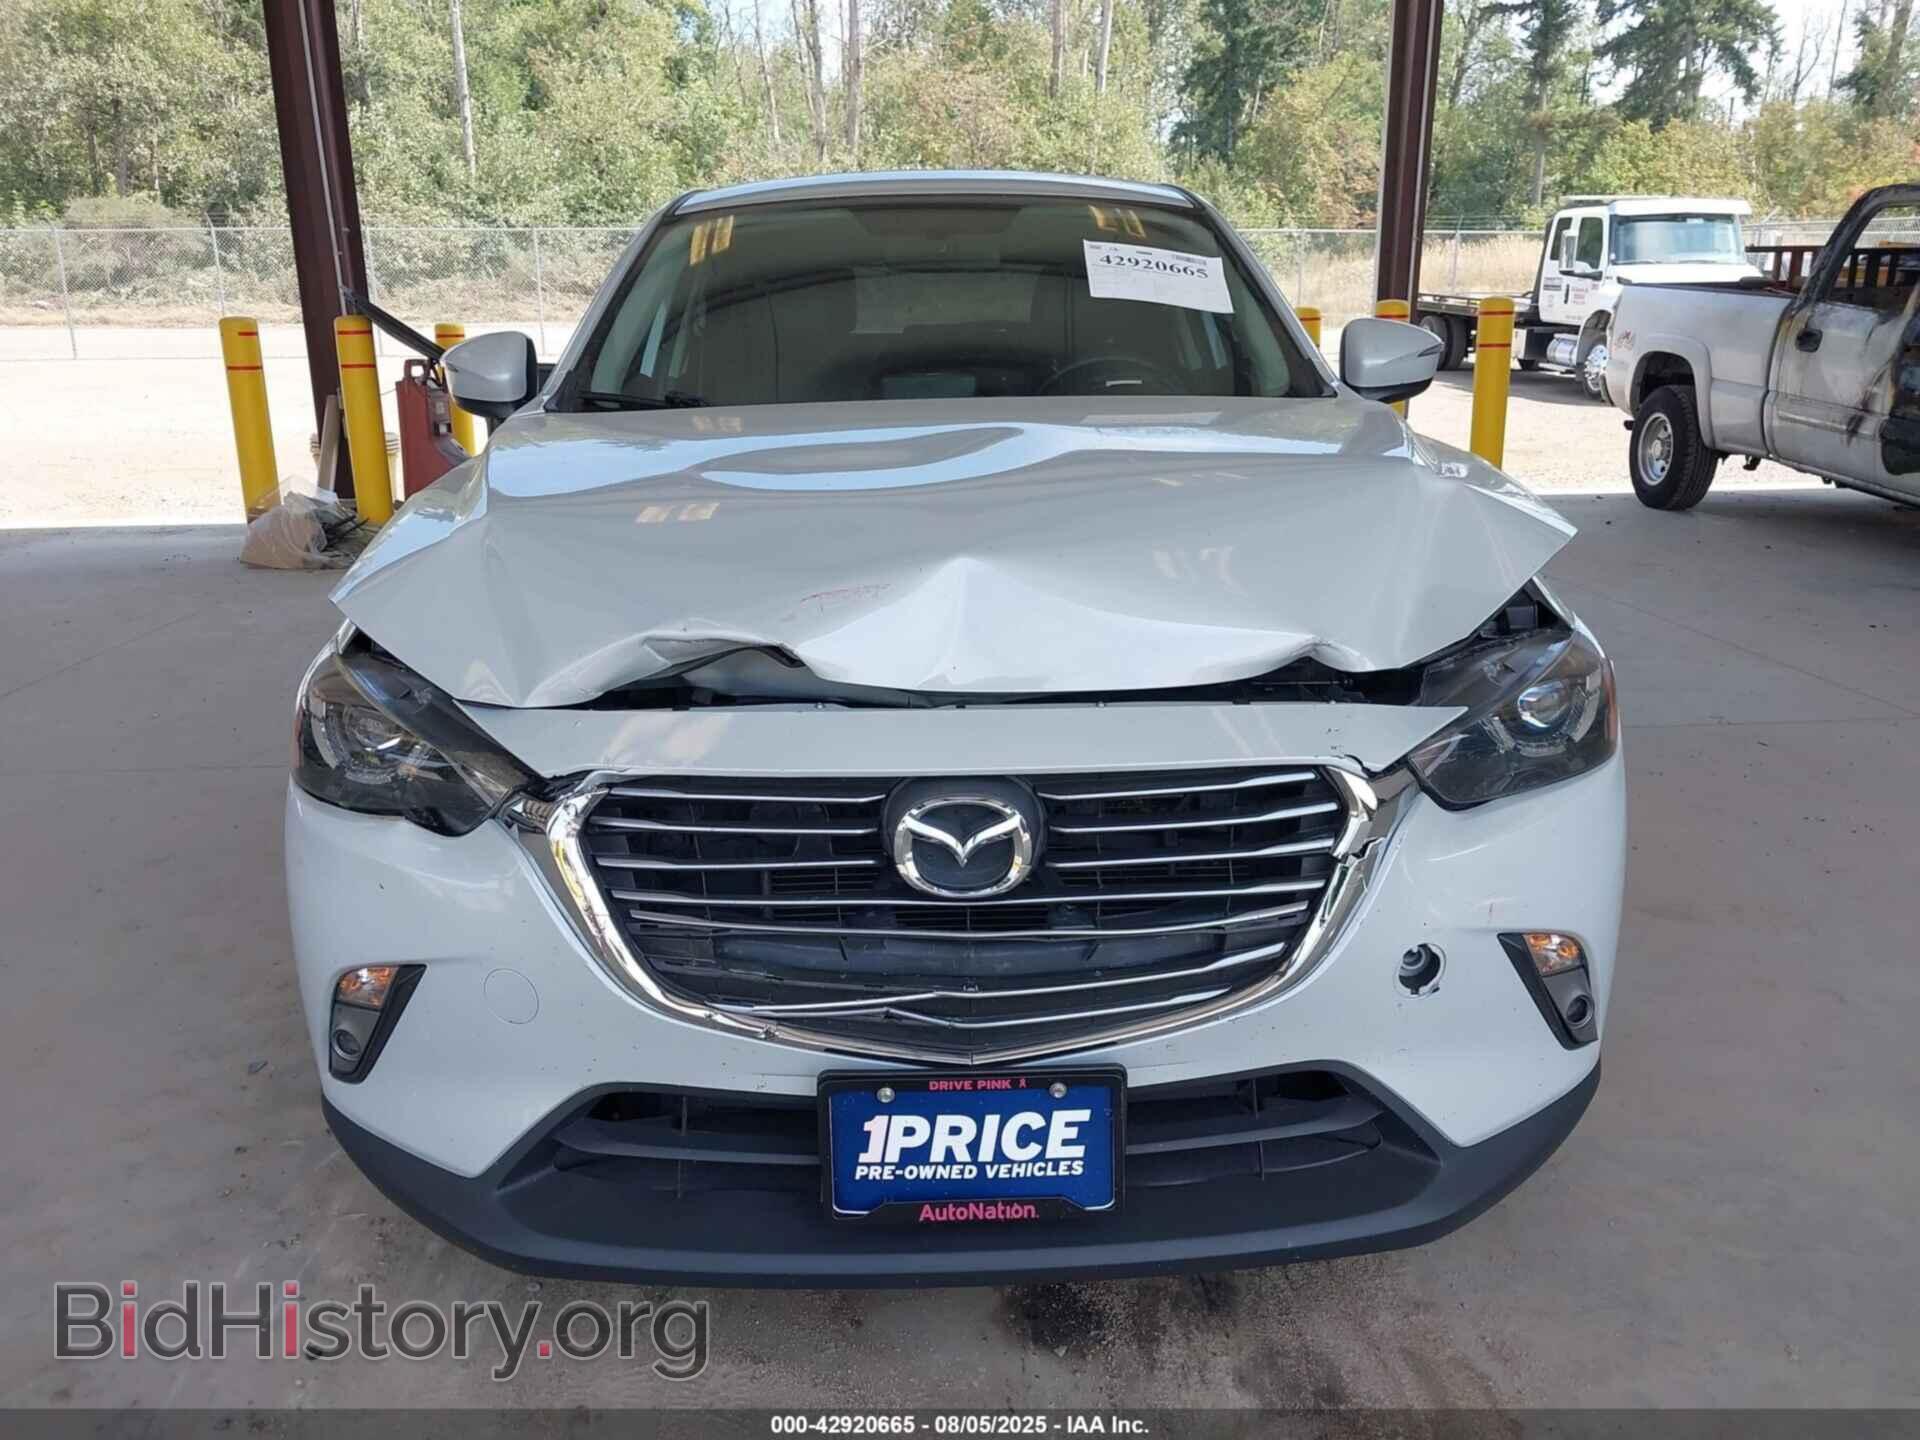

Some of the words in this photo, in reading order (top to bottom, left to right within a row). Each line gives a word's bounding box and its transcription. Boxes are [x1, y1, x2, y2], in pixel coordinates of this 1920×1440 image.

[1099, 254, 1209, 279] 42920665
[928, 1080, 973, 1091] DRIVE
[977, 1079, 1011, 1089] PINK
[859, 1109, 1091, 1163] 1PRICE
[855, 1164, 978, 1180] PRE-OWNED
[985, 1160, 1084, 1178] VEHICLES
[919, 1203, 1036, 1222] AutoNation
